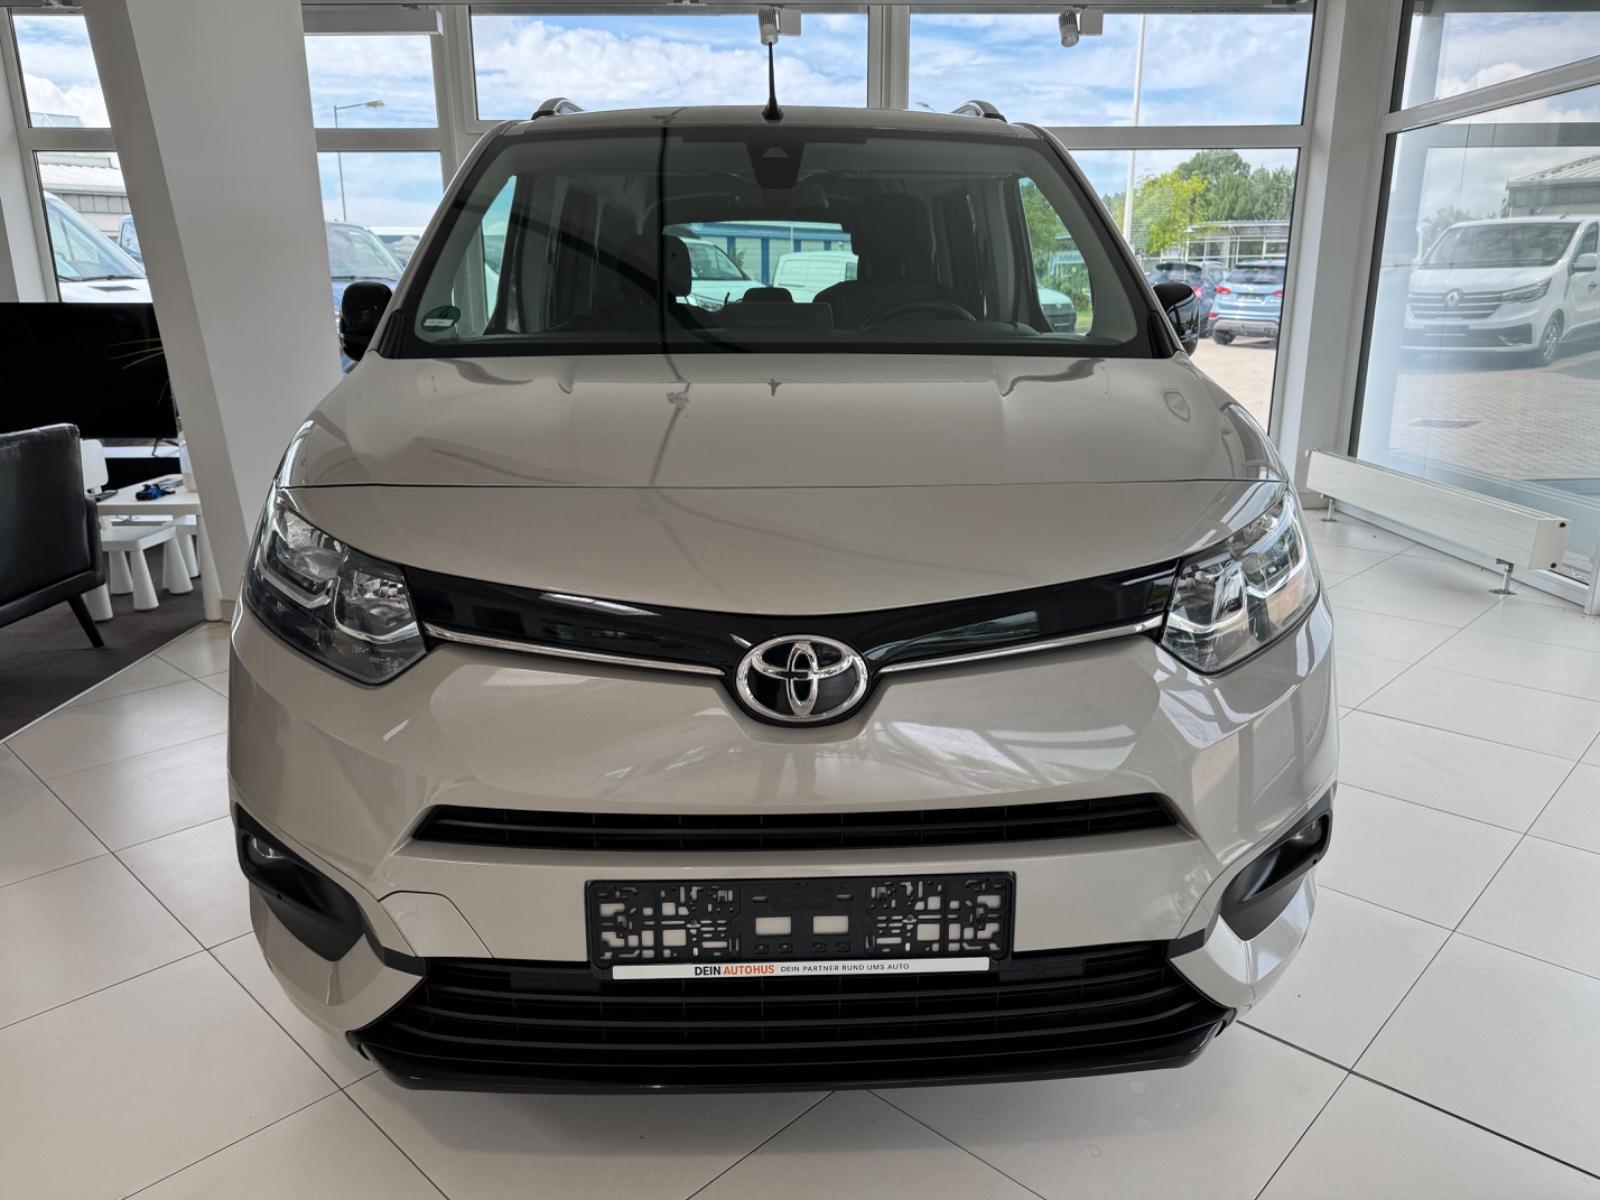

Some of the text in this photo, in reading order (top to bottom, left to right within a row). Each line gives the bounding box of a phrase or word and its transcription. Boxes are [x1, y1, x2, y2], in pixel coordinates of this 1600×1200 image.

[694, 965, 775, 976] DEIN AUTOHUS
[803, 965, 839, 973] PARTNER
[842, 964, 864, 972] RUND
[867, 963, 885, 971] UMS
[887, 963, 910, 971] AUTO
